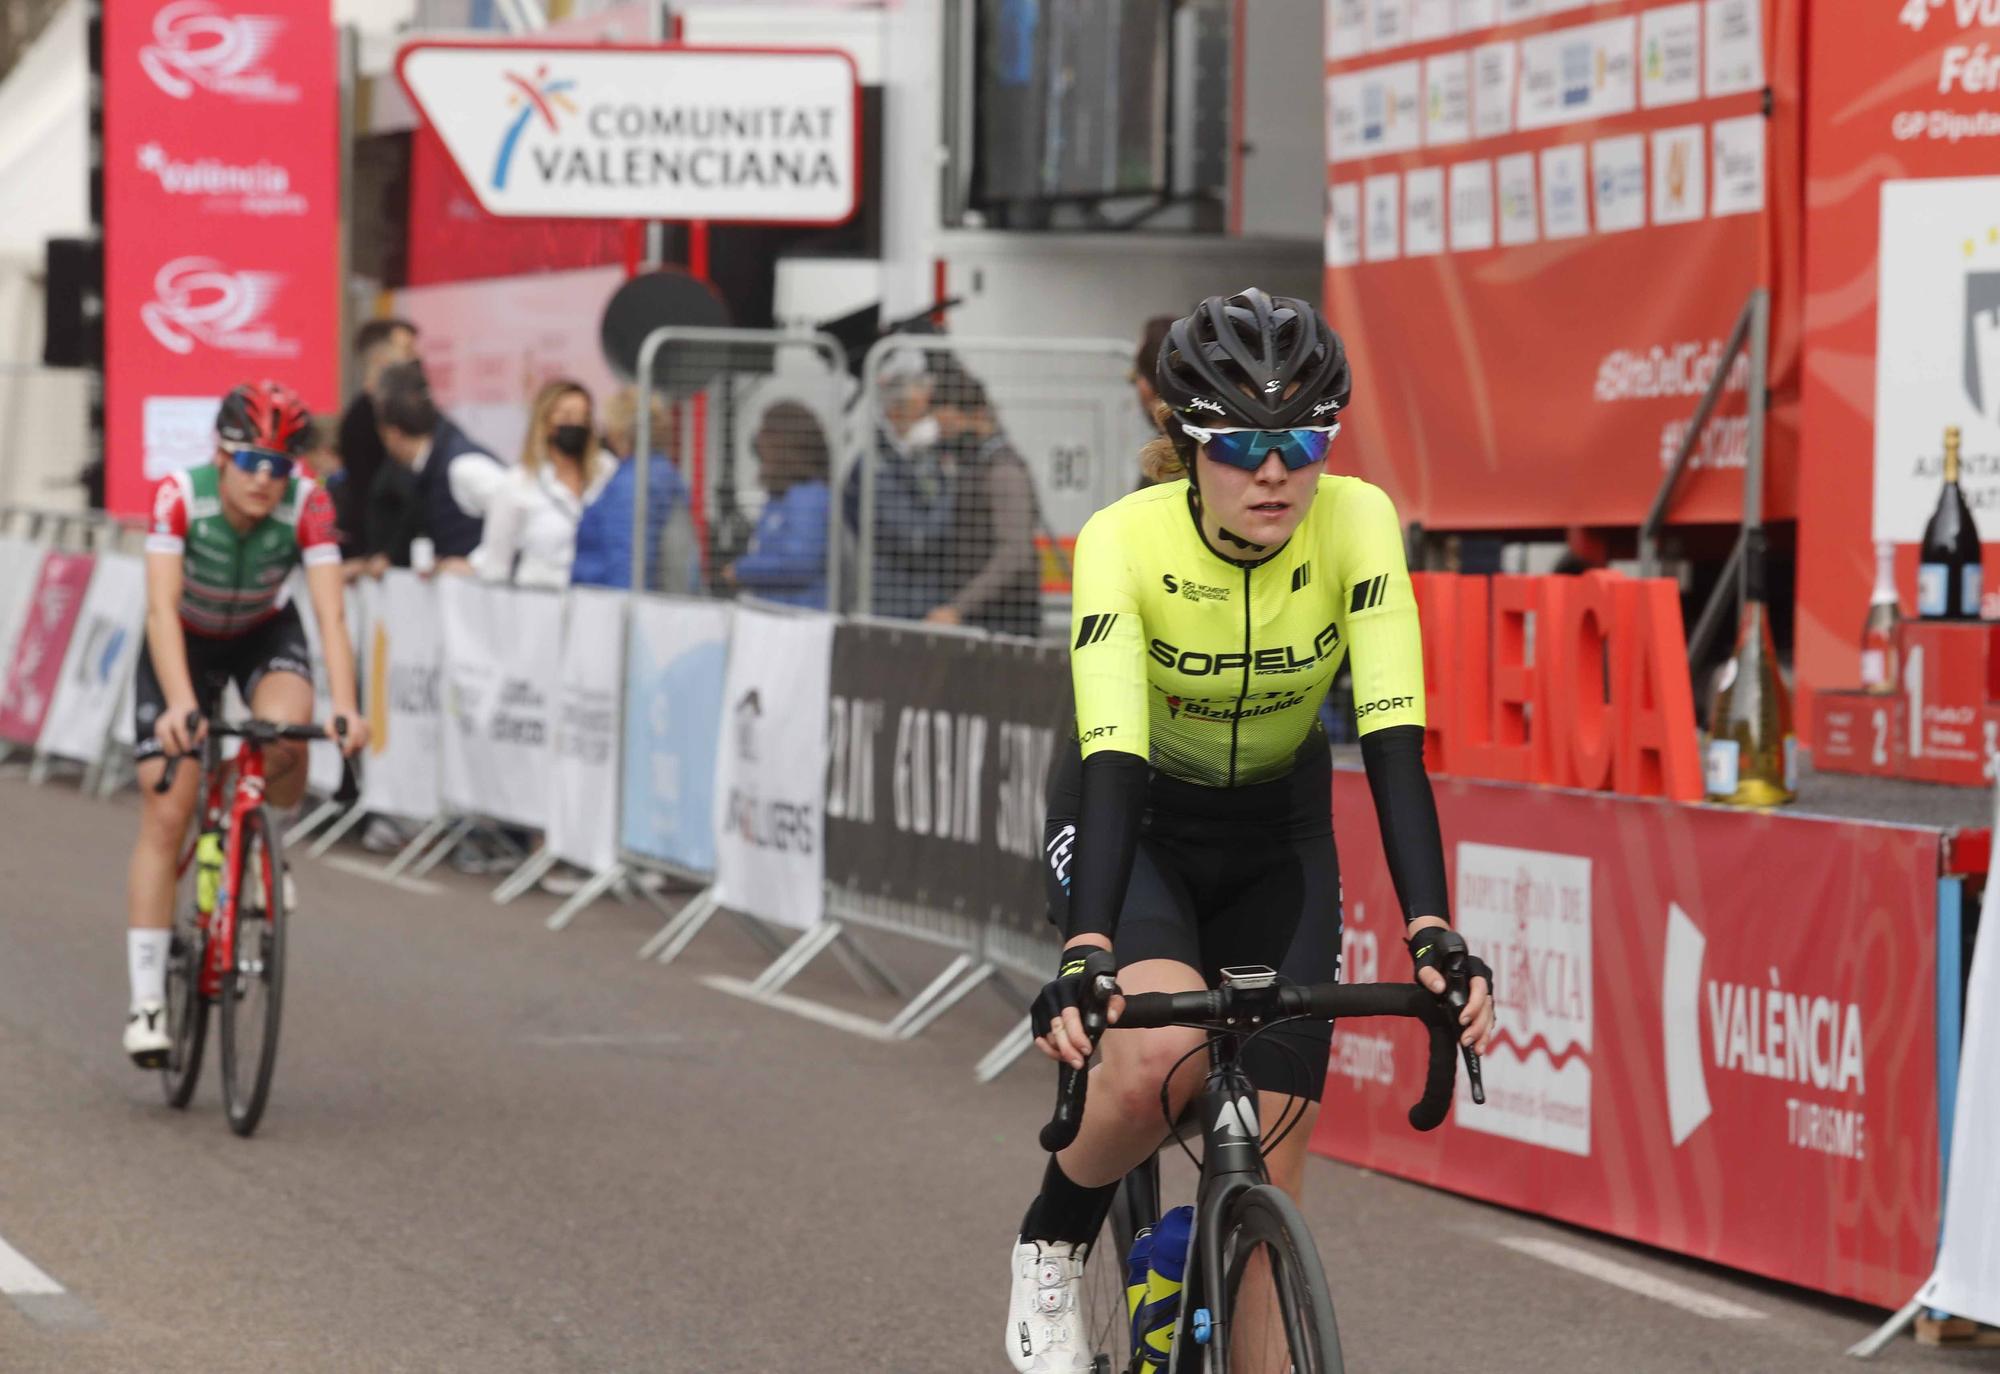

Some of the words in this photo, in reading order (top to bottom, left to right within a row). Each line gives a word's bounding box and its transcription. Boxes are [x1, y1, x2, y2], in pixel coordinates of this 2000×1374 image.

[588, 104, 834, 141] COMUNITAT
[533, 147, 839, 191] VALENCIANA
[1148, 622, 1340, 677] SOPELA
[1184, 695, 1304, 721] Bizkaialde
[1708, 966, 1865, 1095] VALÈNCIA
[1786, 1098, 1864, 1160] TURISME
